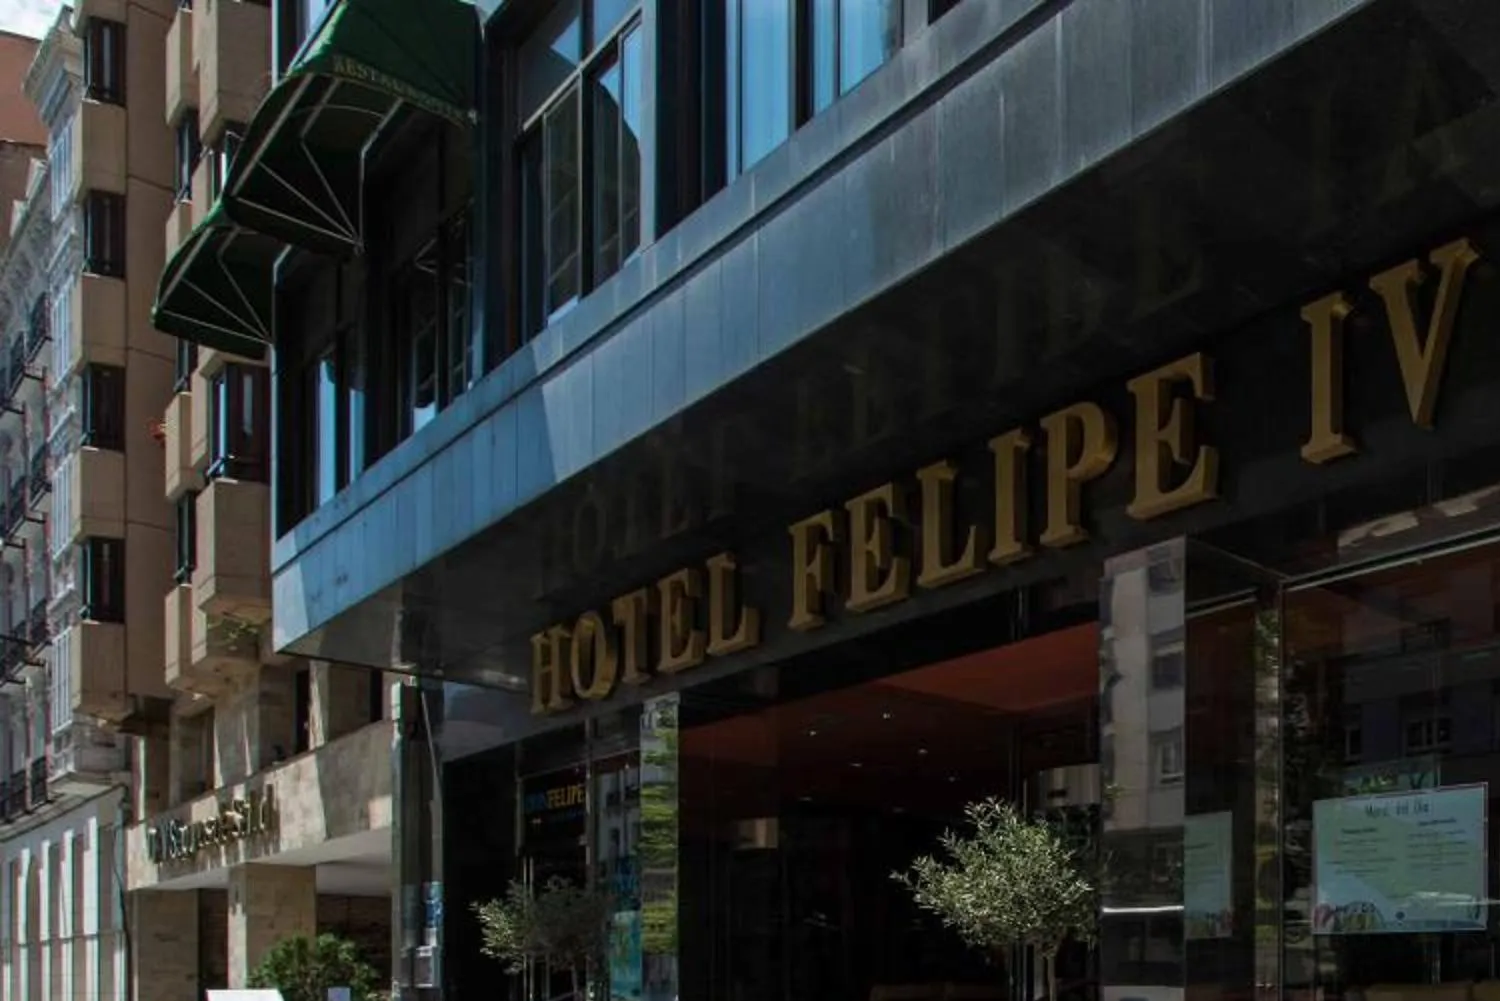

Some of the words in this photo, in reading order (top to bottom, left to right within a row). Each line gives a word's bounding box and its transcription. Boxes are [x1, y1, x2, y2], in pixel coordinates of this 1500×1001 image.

[529, 552, 760, 716] HOTEL
[787, 351, 1220, 633] FELIPE
[1299, 236, 1479, 464] IV
